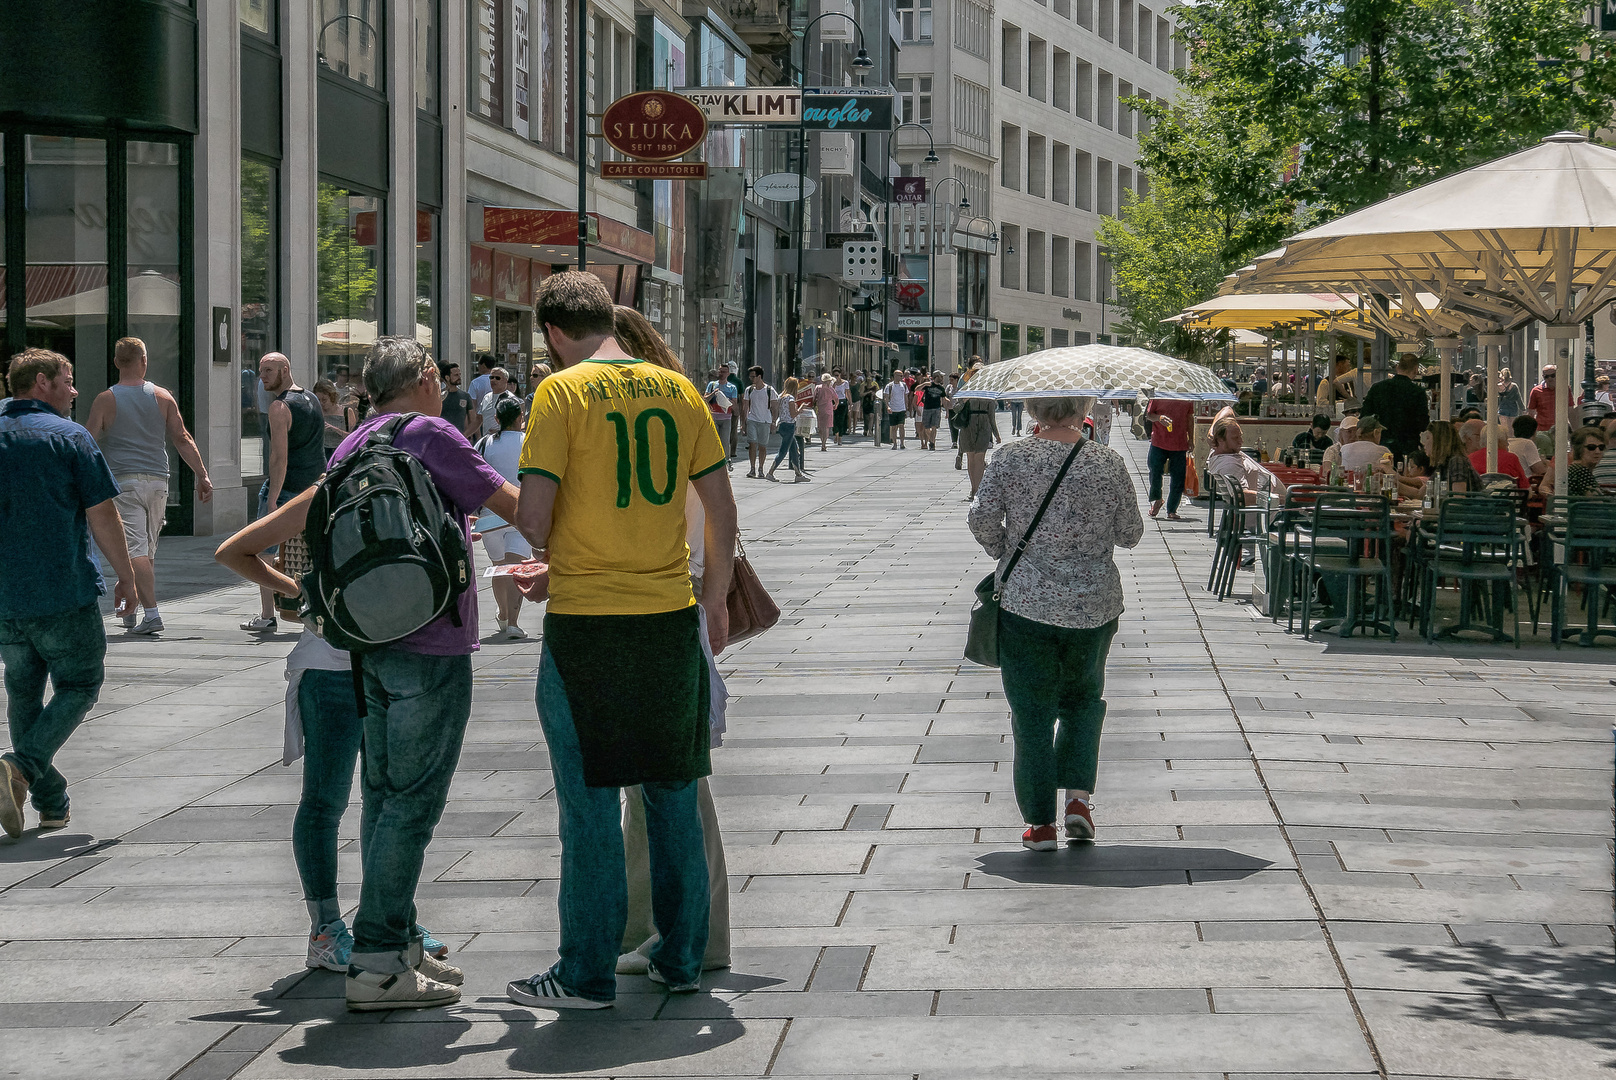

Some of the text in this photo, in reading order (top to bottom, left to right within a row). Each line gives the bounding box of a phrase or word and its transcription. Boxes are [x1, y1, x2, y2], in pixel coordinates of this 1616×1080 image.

[724, 94, 800, 116] KLIMT
[613, 122, 693, 142] SLUKA
[631, 143, 677, 152] SEIT 1891
[608, 165, 699, 174] CAFÉ CONDITOREI
[896, 194, 922, 202] QATAR
[586, 376, 662, 402] NEYMAR
[605, 407, 679, 509] 10
